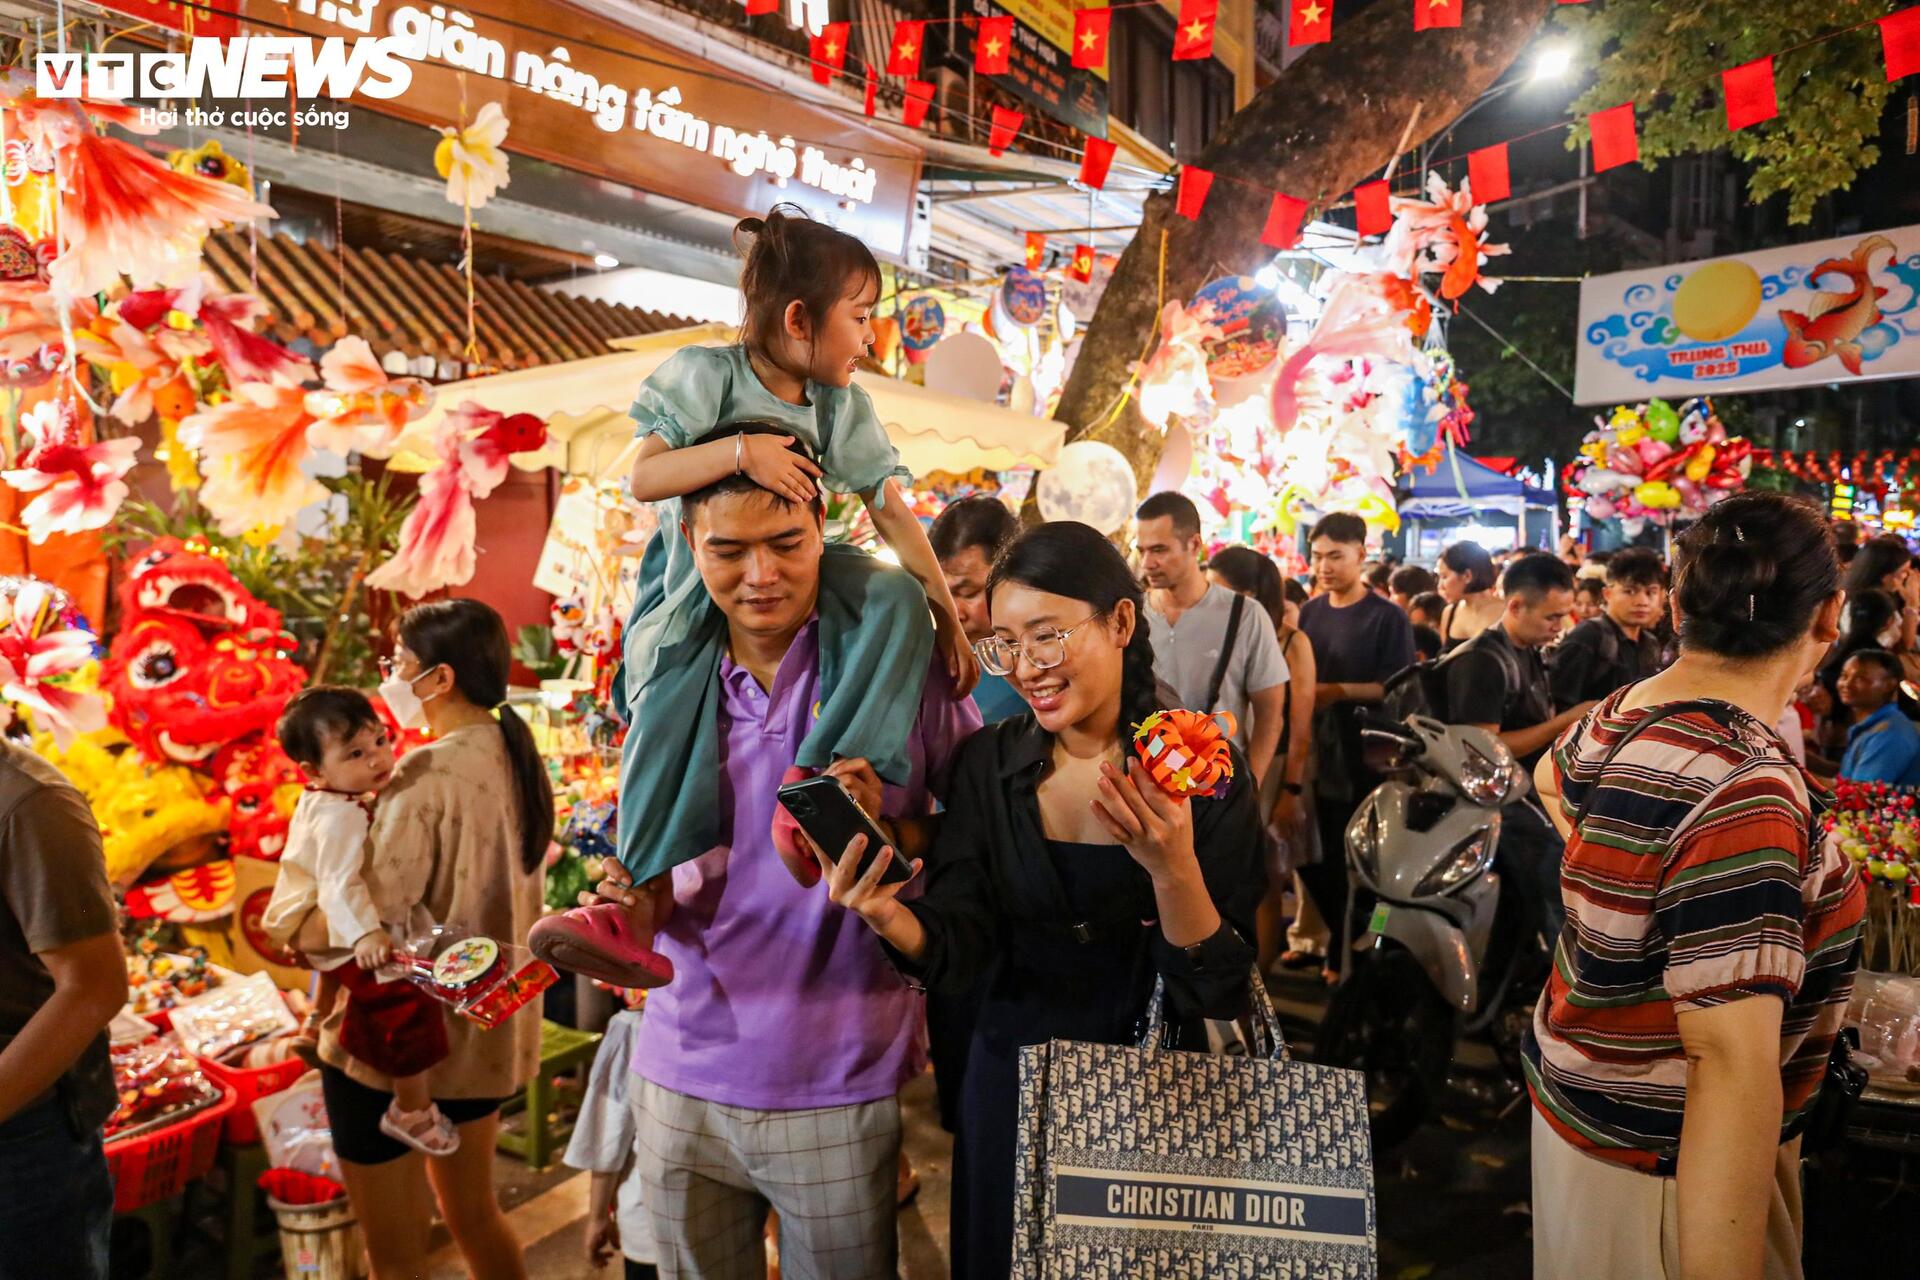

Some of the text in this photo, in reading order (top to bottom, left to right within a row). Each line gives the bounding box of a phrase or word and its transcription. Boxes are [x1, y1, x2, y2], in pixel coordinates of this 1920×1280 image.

[514, 46, 628, 133] nâng
[713, 130, 797, 189] nghệ
[801, 147, 876, 212] thuật
[1668, 340, 1770, 365] TRUNG THU
[1694, 360, 1738, 378] 2025
[1106, 1183, 1306, 1227] CHRISTIAN DIOR
